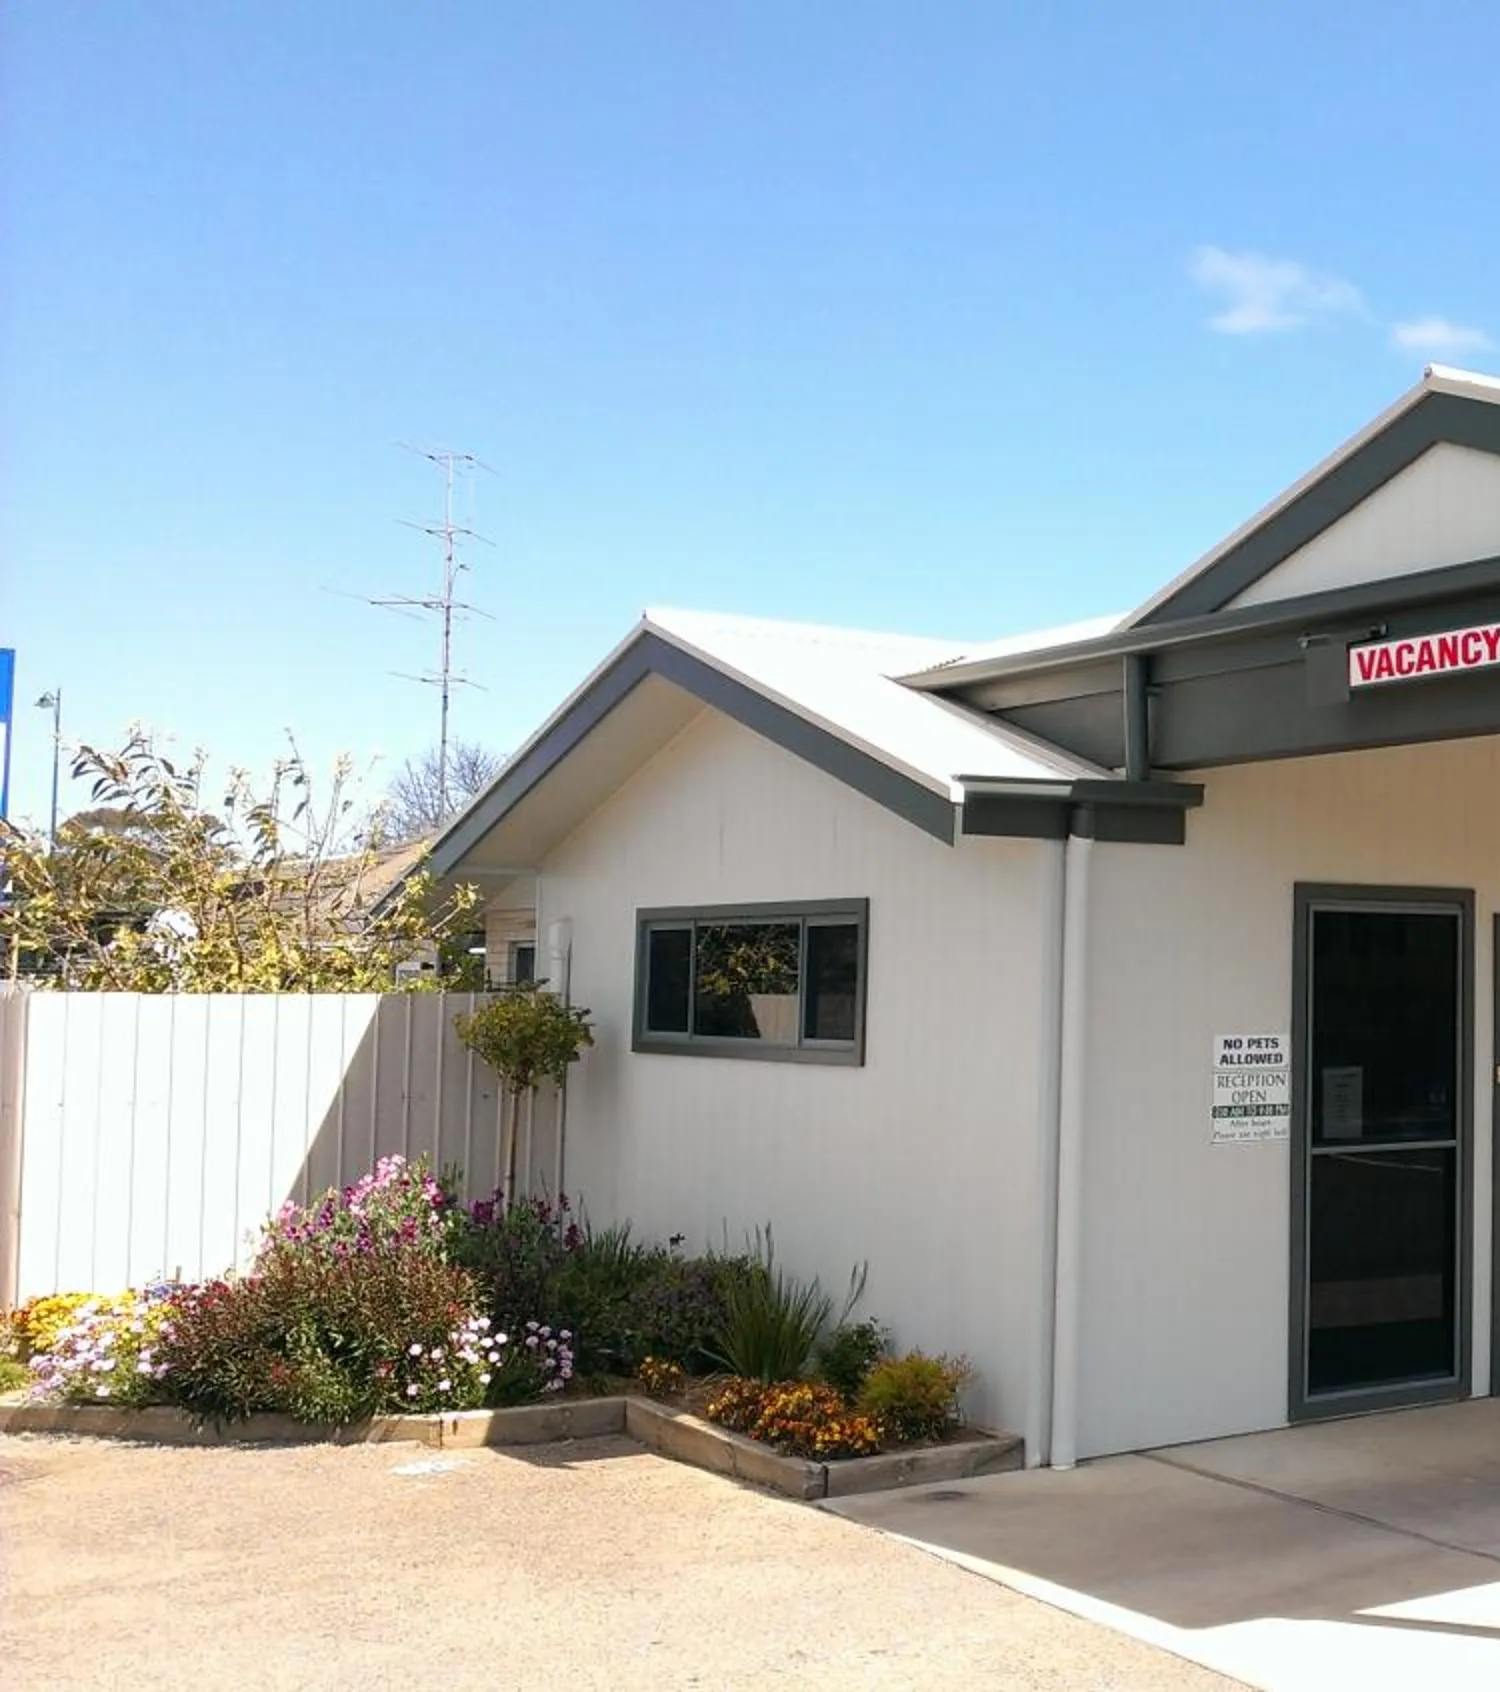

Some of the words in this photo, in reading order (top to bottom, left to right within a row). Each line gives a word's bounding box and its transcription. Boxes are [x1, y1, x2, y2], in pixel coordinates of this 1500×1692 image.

[1223, 1039, 1242, 1050] NO
[1247, 1037, 1279, 1049] PETS
[1219, 1052, 1284, 1066] ALLOWED
[1217, 1073, 1285, 1089] RECEPTION
[1231, 1090, 1267, 1103] OPEN
